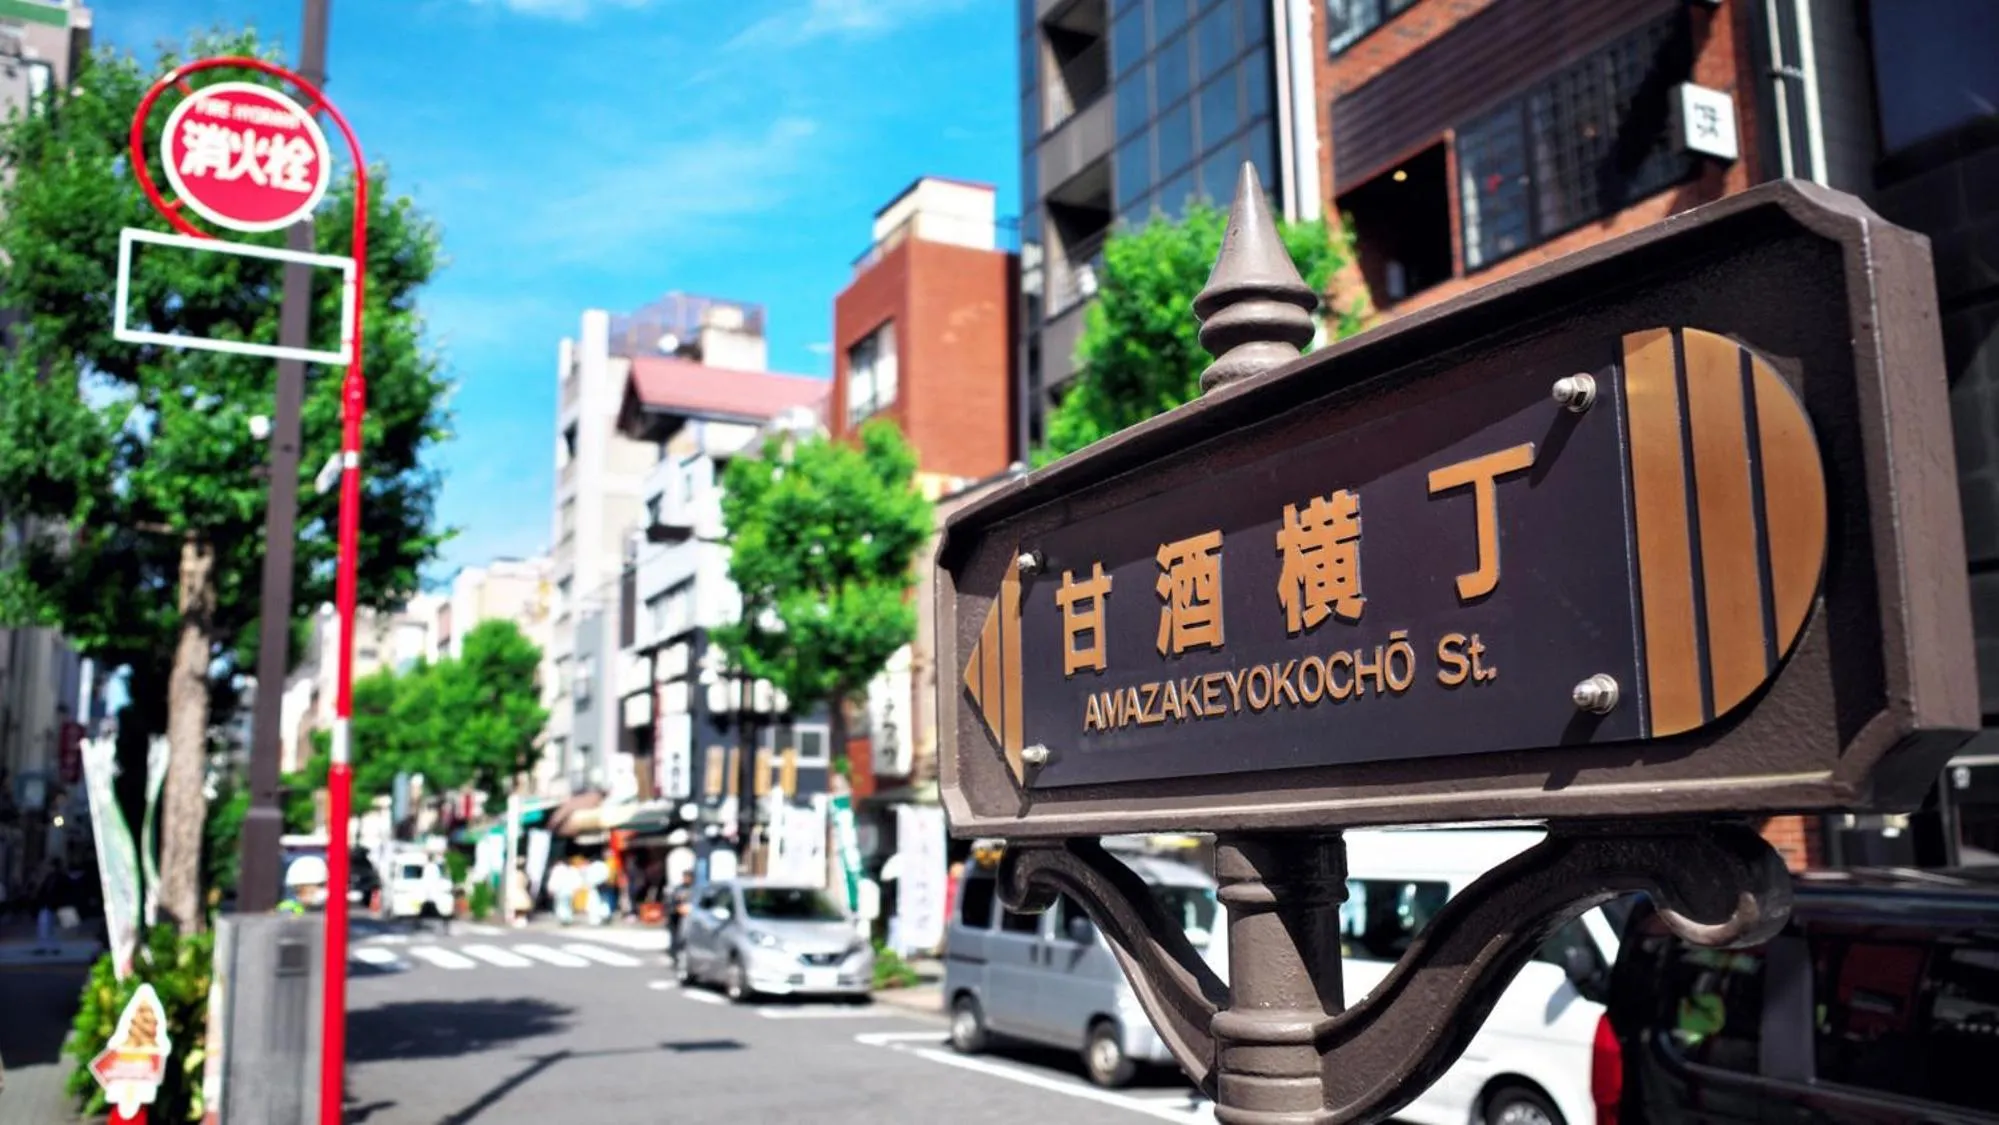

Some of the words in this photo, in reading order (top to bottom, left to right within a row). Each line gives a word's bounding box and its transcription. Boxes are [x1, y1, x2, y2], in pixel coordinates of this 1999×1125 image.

[181, 119, 315, 192] 消火栓
[1056, 442, 1534, 676] 甘酒横丁
[1083, 630, 1415, 732] AMAZAKEYOKOCHŌ
[1437, 633, 1497, 687] St.
